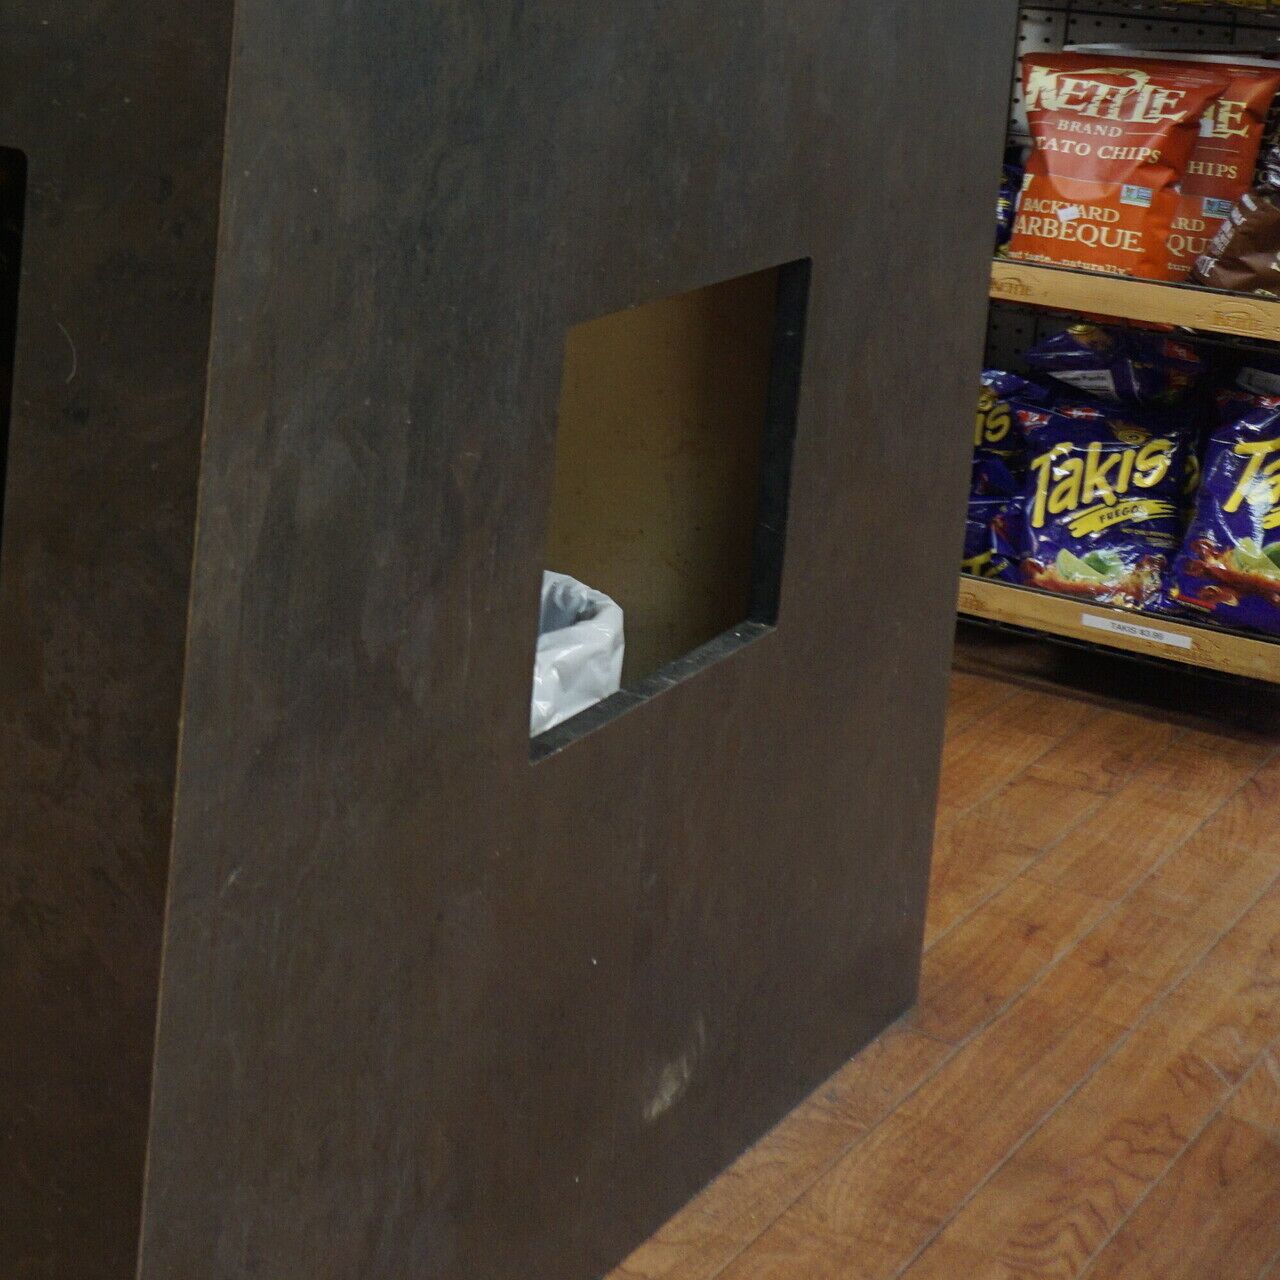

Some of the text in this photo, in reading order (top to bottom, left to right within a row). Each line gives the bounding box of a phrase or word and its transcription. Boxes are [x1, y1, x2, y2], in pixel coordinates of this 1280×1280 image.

[1024, 66, 1188, 125] KETTLE
[1056, 119, 1124, 138] BRAND
[1096, 145, 1162, 165] CHIPS
[1013, 216, 1146, 254] ARBEQUE
[1111, 622, 1138, 636] TAKIS
